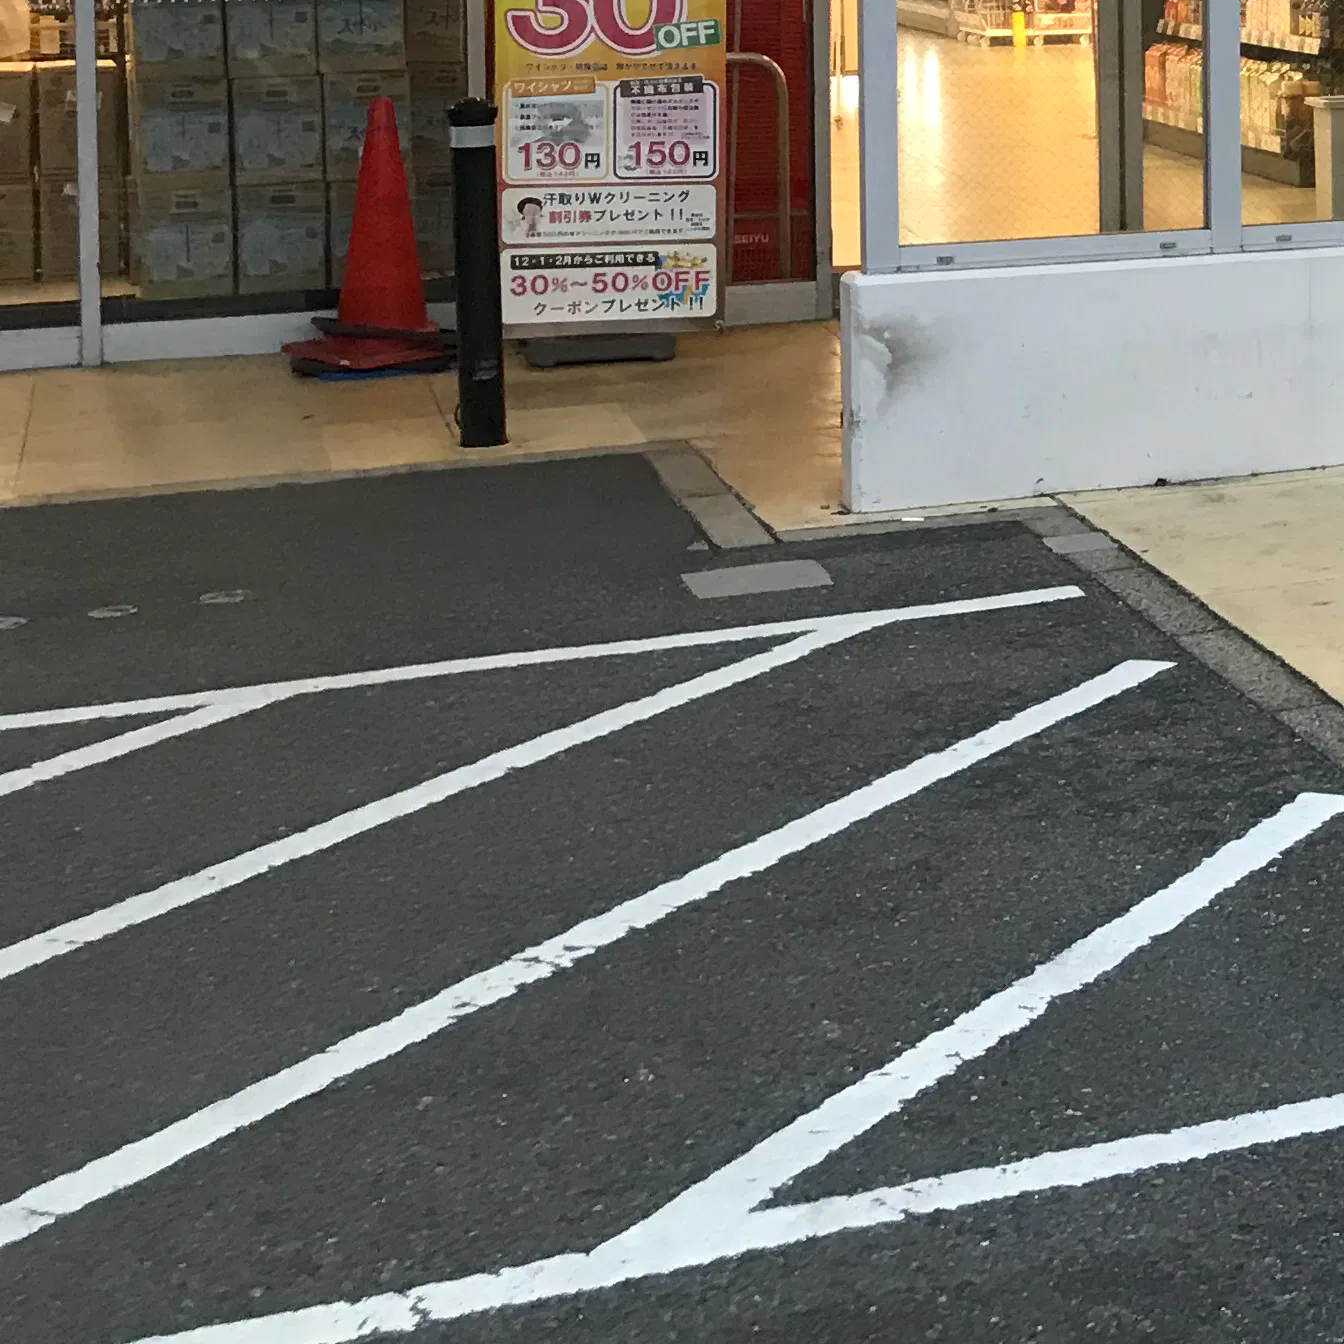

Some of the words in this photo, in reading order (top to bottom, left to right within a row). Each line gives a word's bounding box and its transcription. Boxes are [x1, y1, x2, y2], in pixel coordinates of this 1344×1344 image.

[657, 21, 717, 48] OFF
[517, 141, 600, 171] 130円
[631, 140, 709, 168] 150円
[543, 189, 691, 206] 汗取りWクリーニング
